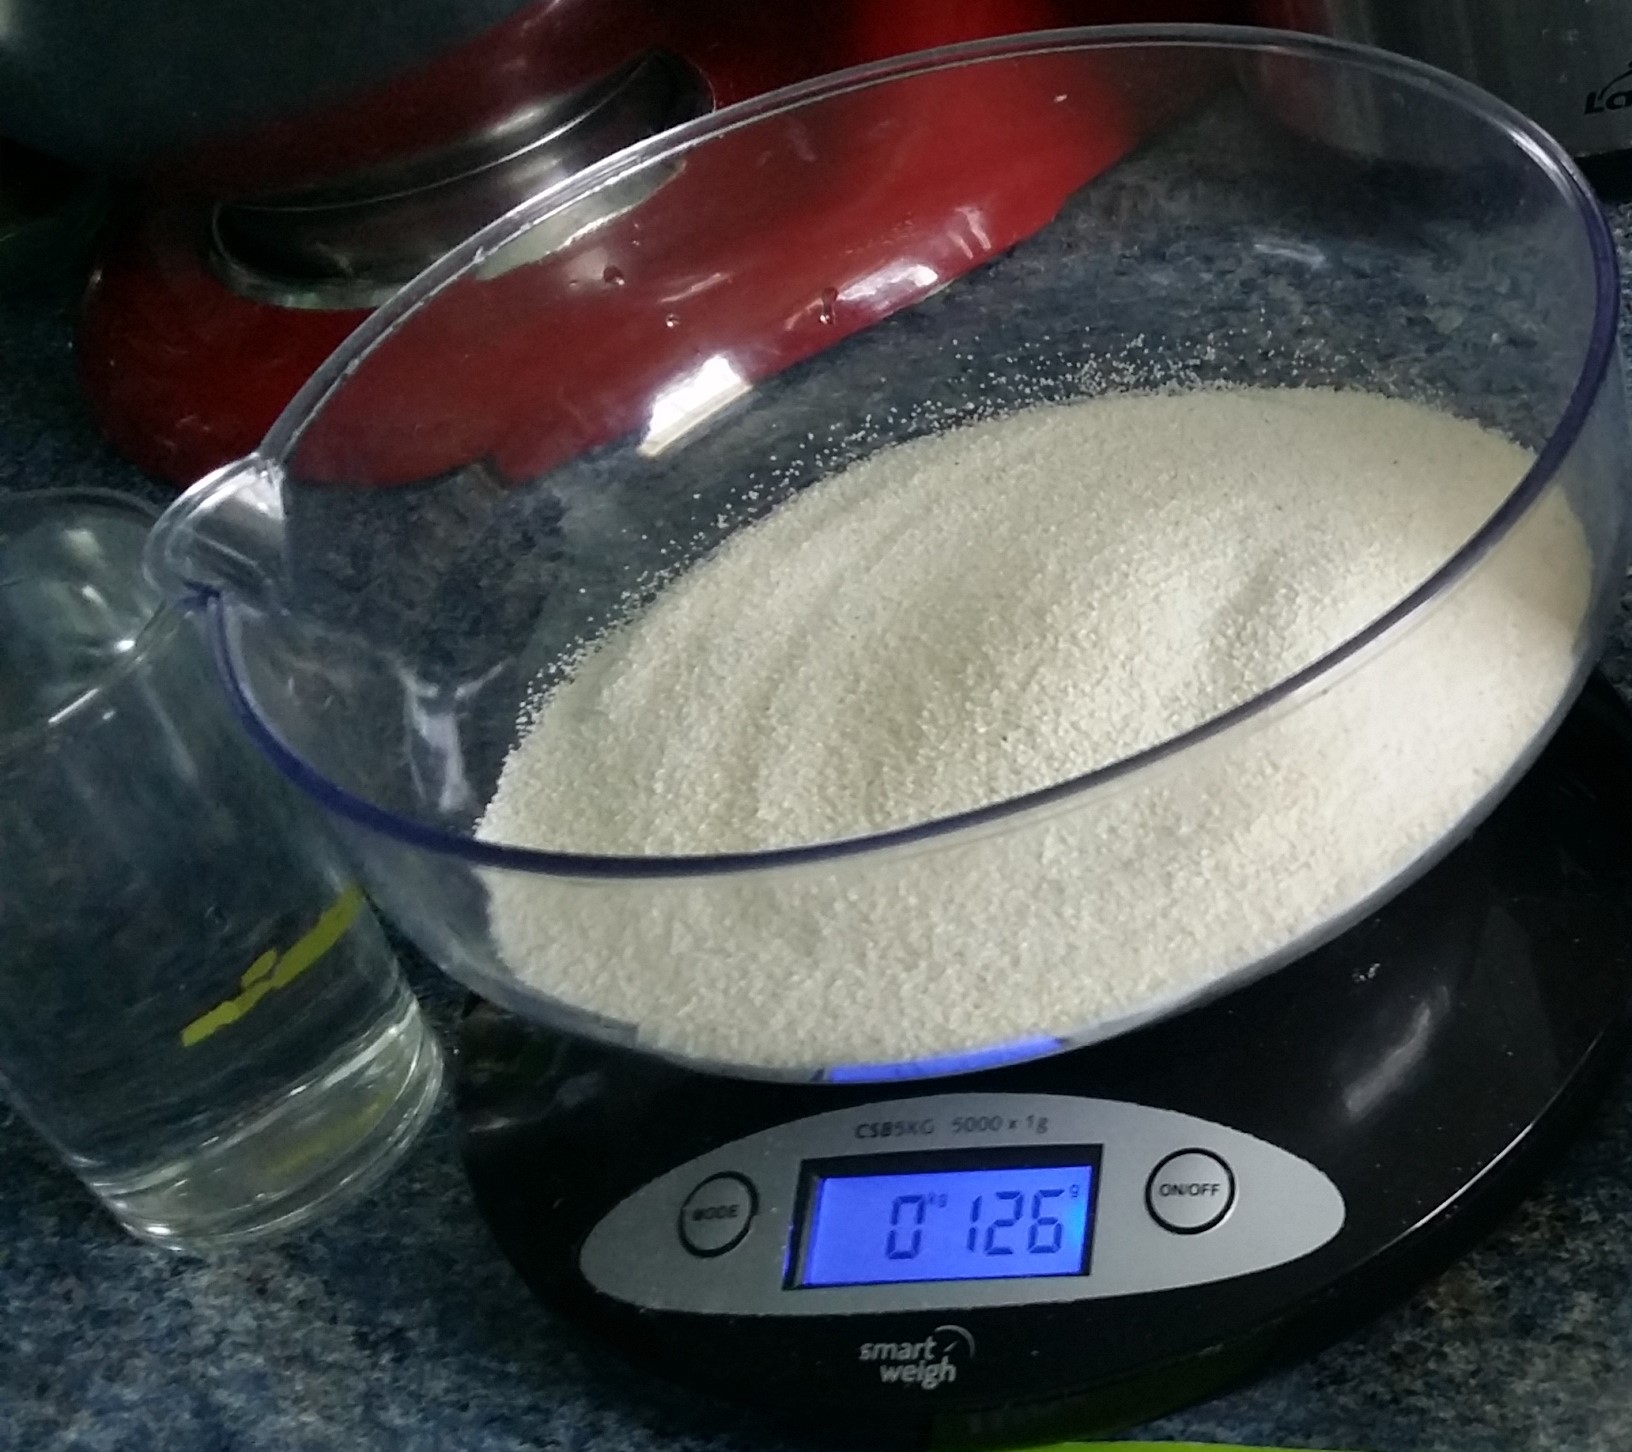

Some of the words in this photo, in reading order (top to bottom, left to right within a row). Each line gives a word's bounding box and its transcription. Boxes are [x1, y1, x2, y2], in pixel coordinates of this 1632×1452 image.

[951, 1114, 1001, 1134] 5000
[1160, 1182, 1221, 1197] ON/OFF
[859, 1335, 938, 1360] smart
[880, 1355, 957, 1390] weigh
